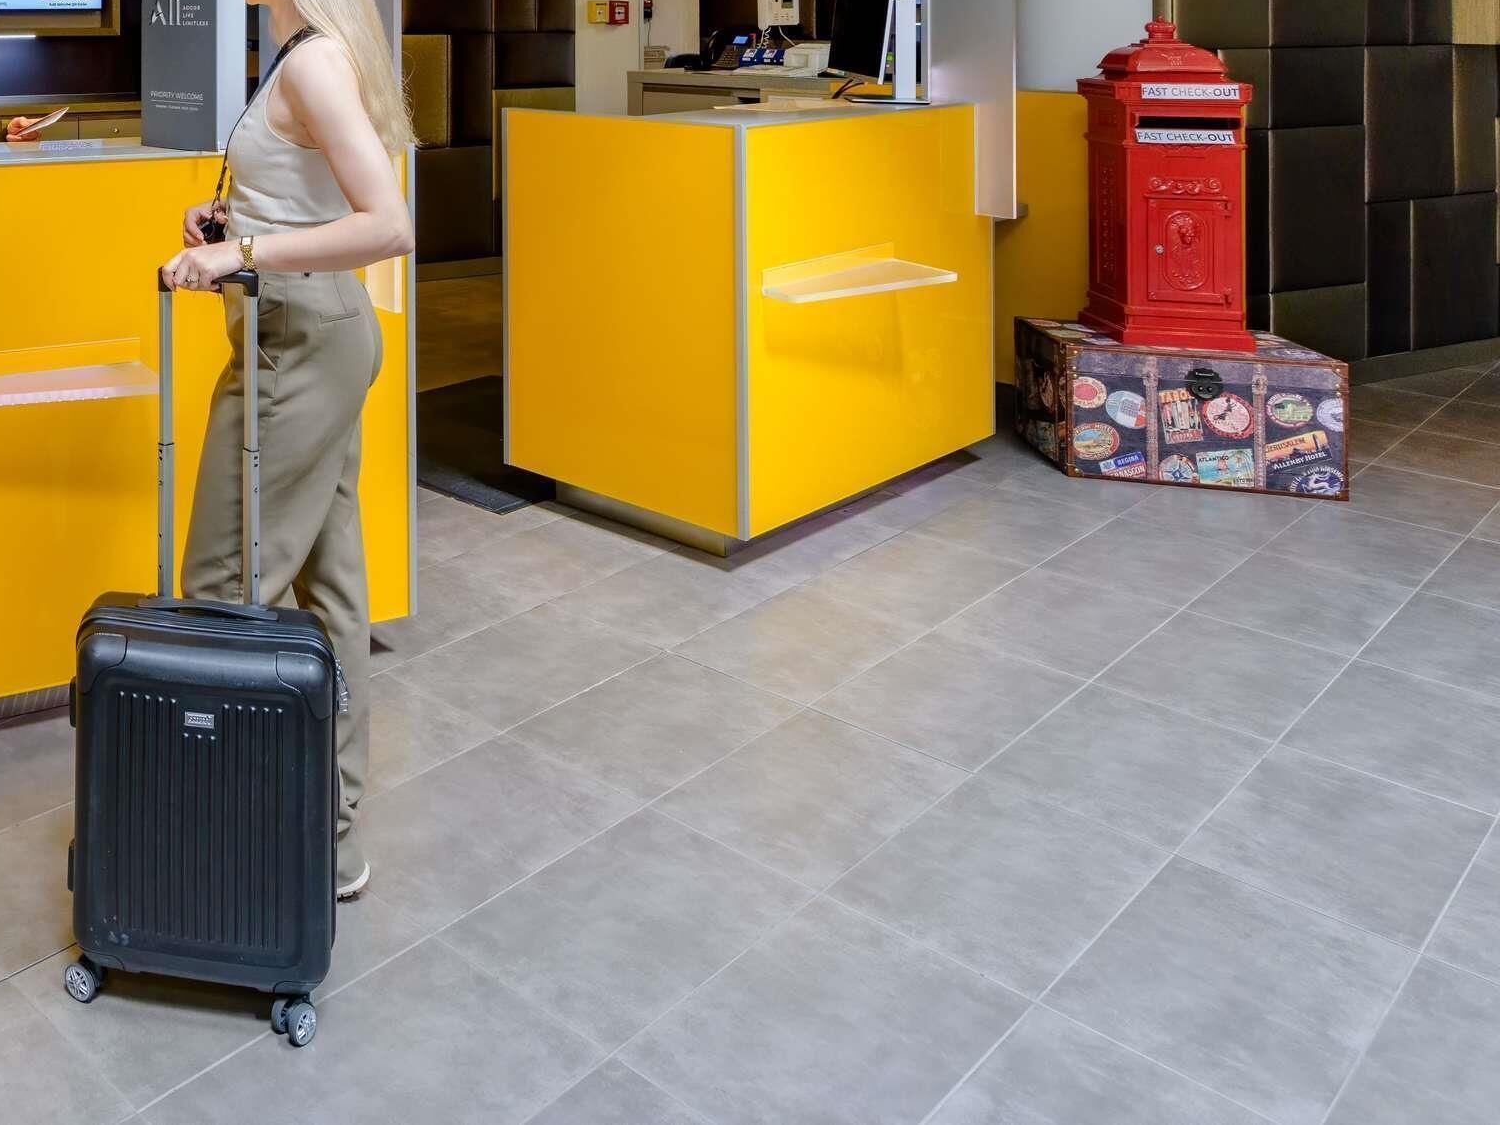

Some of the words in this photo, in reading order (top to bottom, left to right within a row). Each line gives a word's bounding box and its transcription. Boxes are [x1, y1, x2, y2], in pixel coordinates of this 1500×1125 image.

[1142, 87, 1168, 96] FAST
[1171, 87, 1239, 97] CHECK-OUT
[1138, 132, 1164, 141] FAST
[1166, 132, 1232, 142] CHECK-OUT
[1304, 451, 1326, 461] HOTEL
